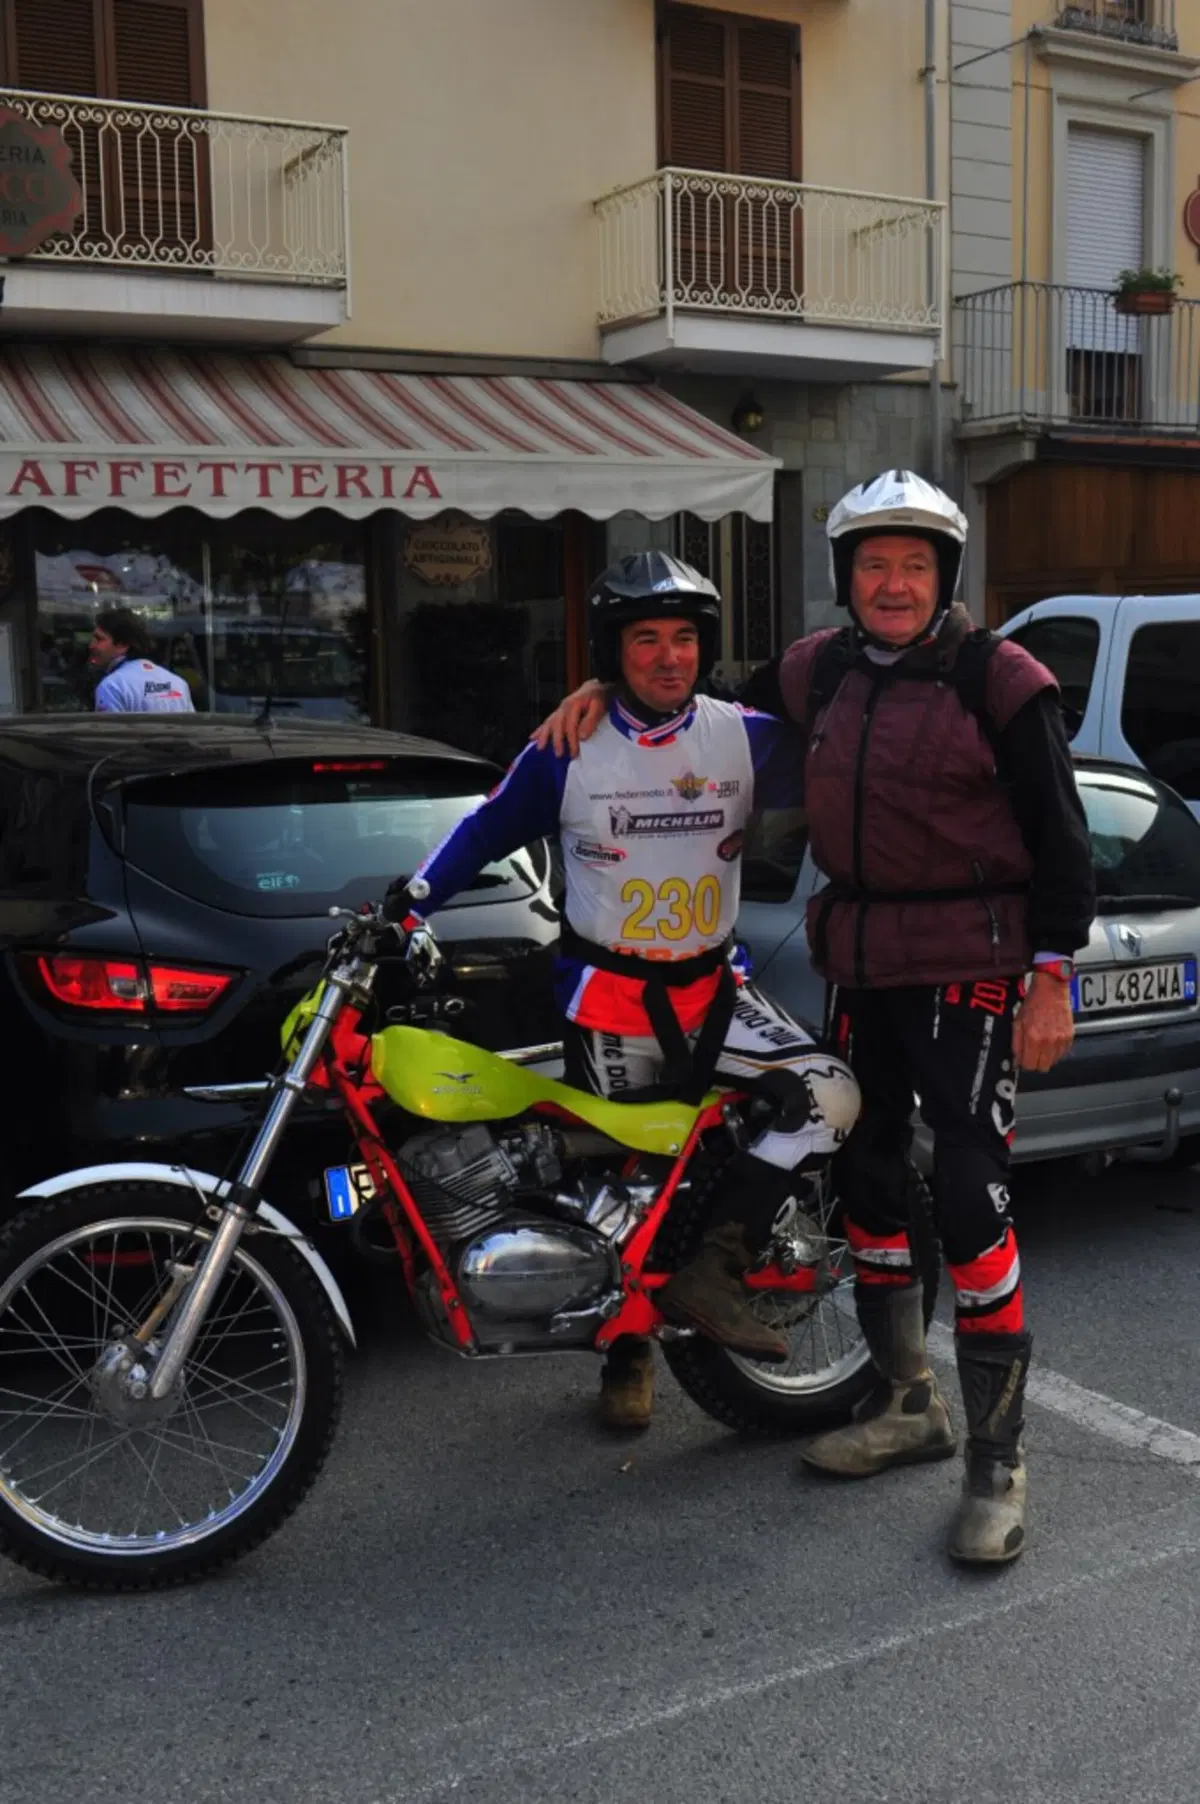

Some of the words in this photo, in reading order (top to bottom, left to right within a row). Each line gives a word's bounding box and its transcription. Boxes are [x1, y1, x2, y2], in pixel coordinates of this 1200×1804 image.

[8, 459, 443, 498] AFFETTERIA
[634, 813, 722, 829] MICHELIN
[621, 874, 720, 941] 230
[1081, 973, 1107, 1007] CJ
[1114, 966, 1181, 1003] 482WA
[384, 998, 466, 1022] CLIO
